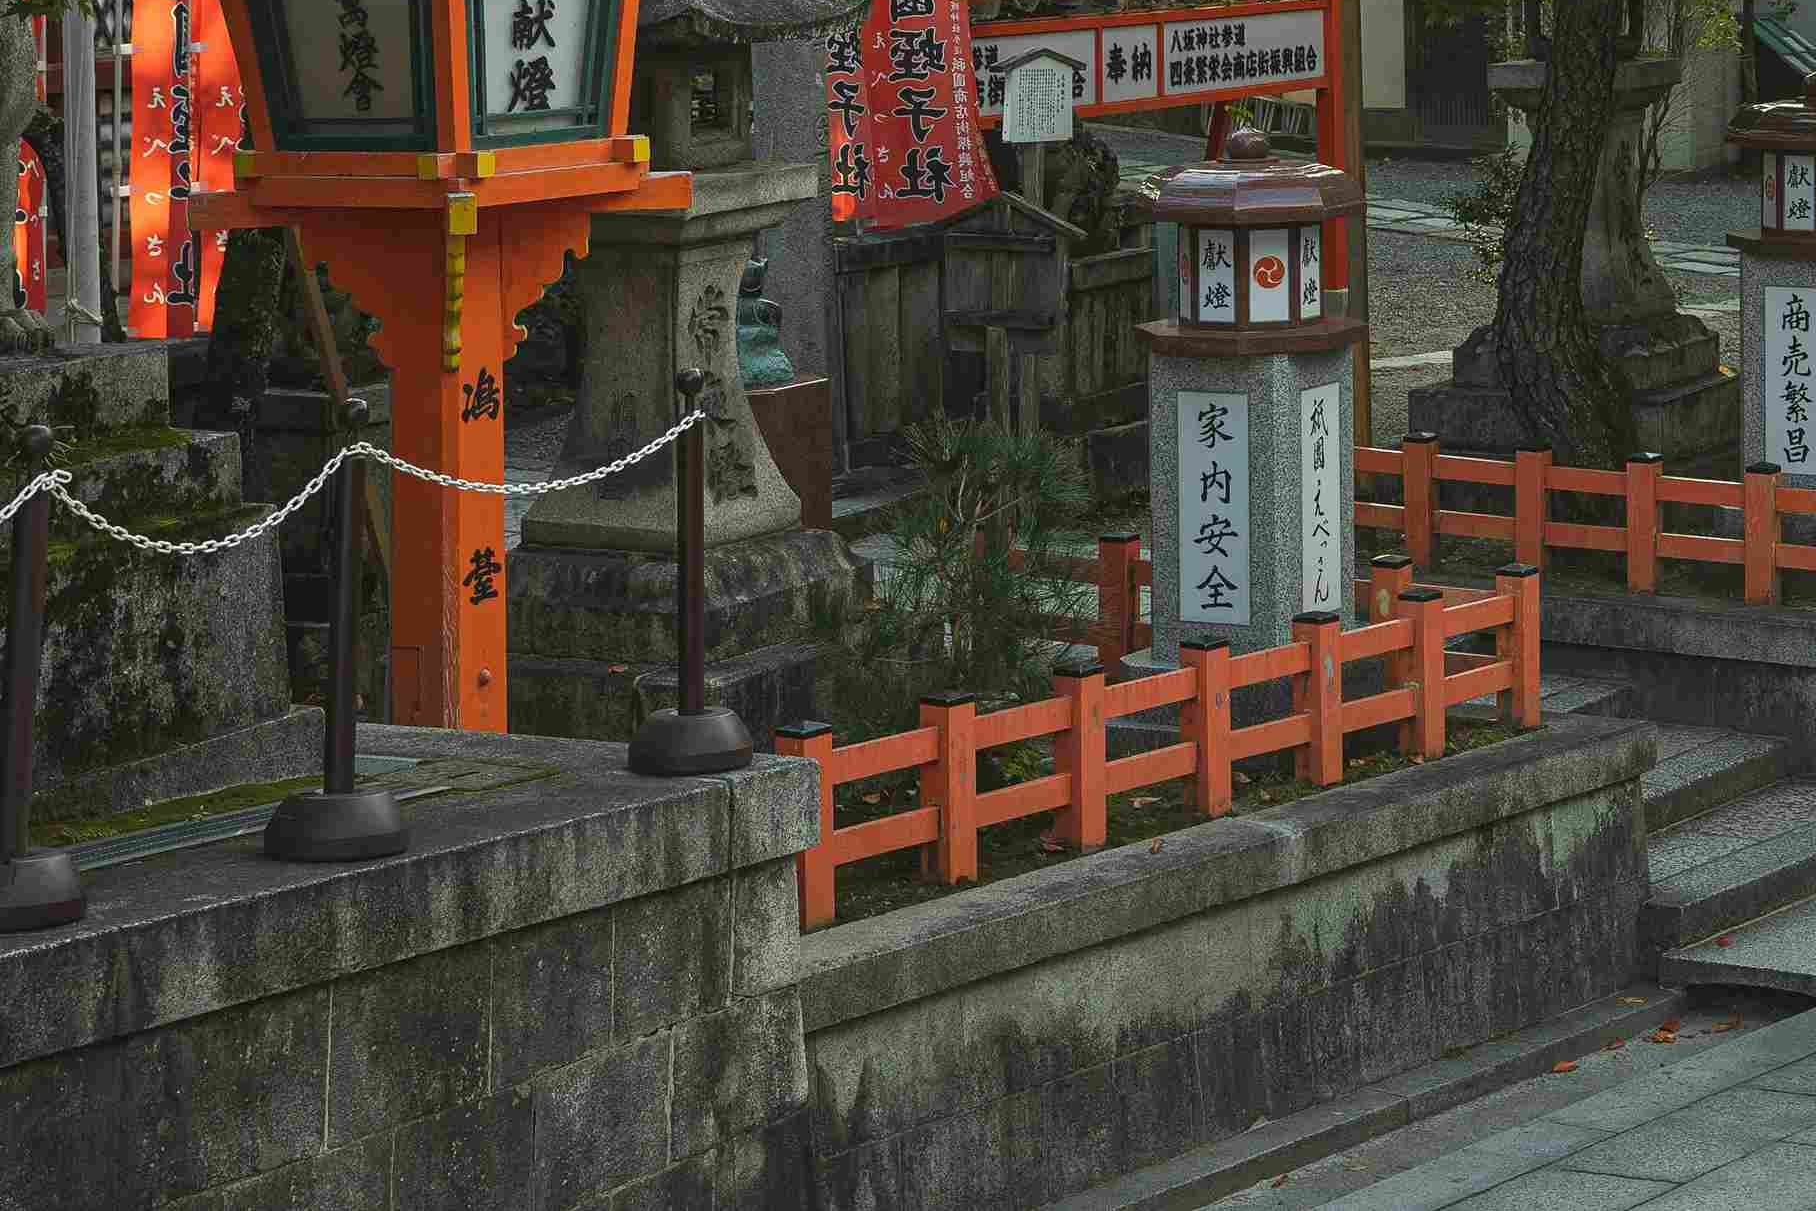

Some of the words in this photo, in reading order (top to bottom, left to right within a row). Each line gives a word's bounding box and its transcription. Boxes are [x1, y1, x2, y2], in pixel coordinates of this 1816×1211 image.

[1105, 42, 1152, 86] 奉納
[1169, 23, 1247, 55] 八坂神社参道
[1780, 292, 1815, 465] 商売繁昌
[1193, 403, 1239, 612] 家内安全
